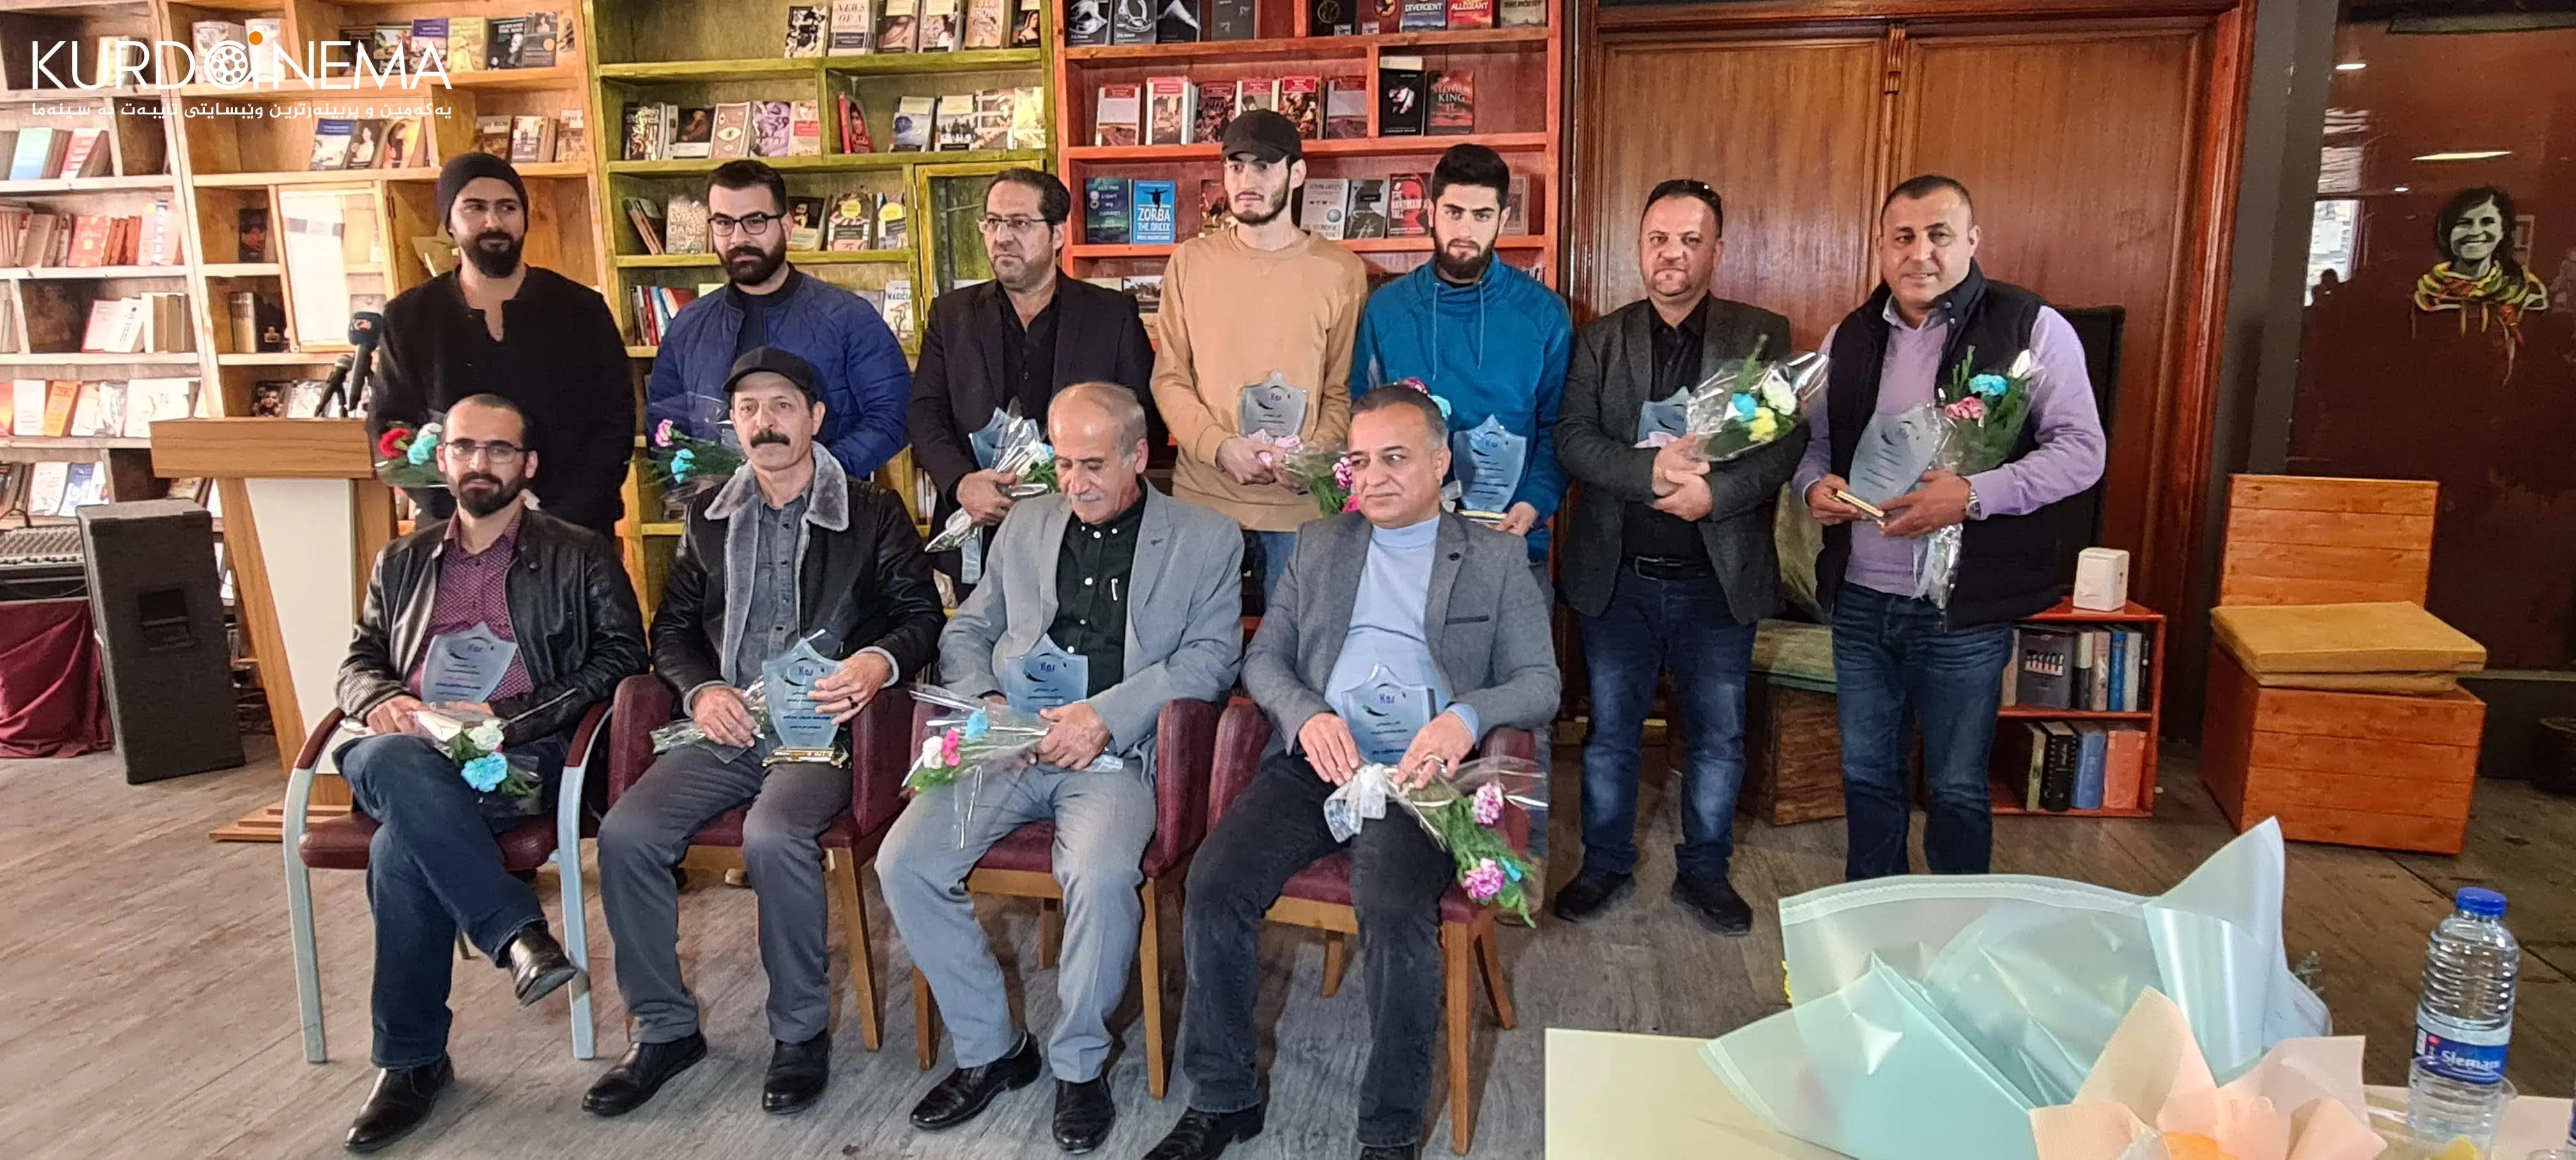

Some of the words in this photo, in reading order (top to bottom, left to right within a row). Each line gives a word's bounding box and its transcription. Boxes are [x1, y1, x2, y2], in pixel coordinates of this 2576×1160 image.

[1405, 3, 1442, 12] DIVERGENT
[1451, 2, 1489, 10] ALLEGIANT
[1137, 208, 1171, 222] ZORBA
